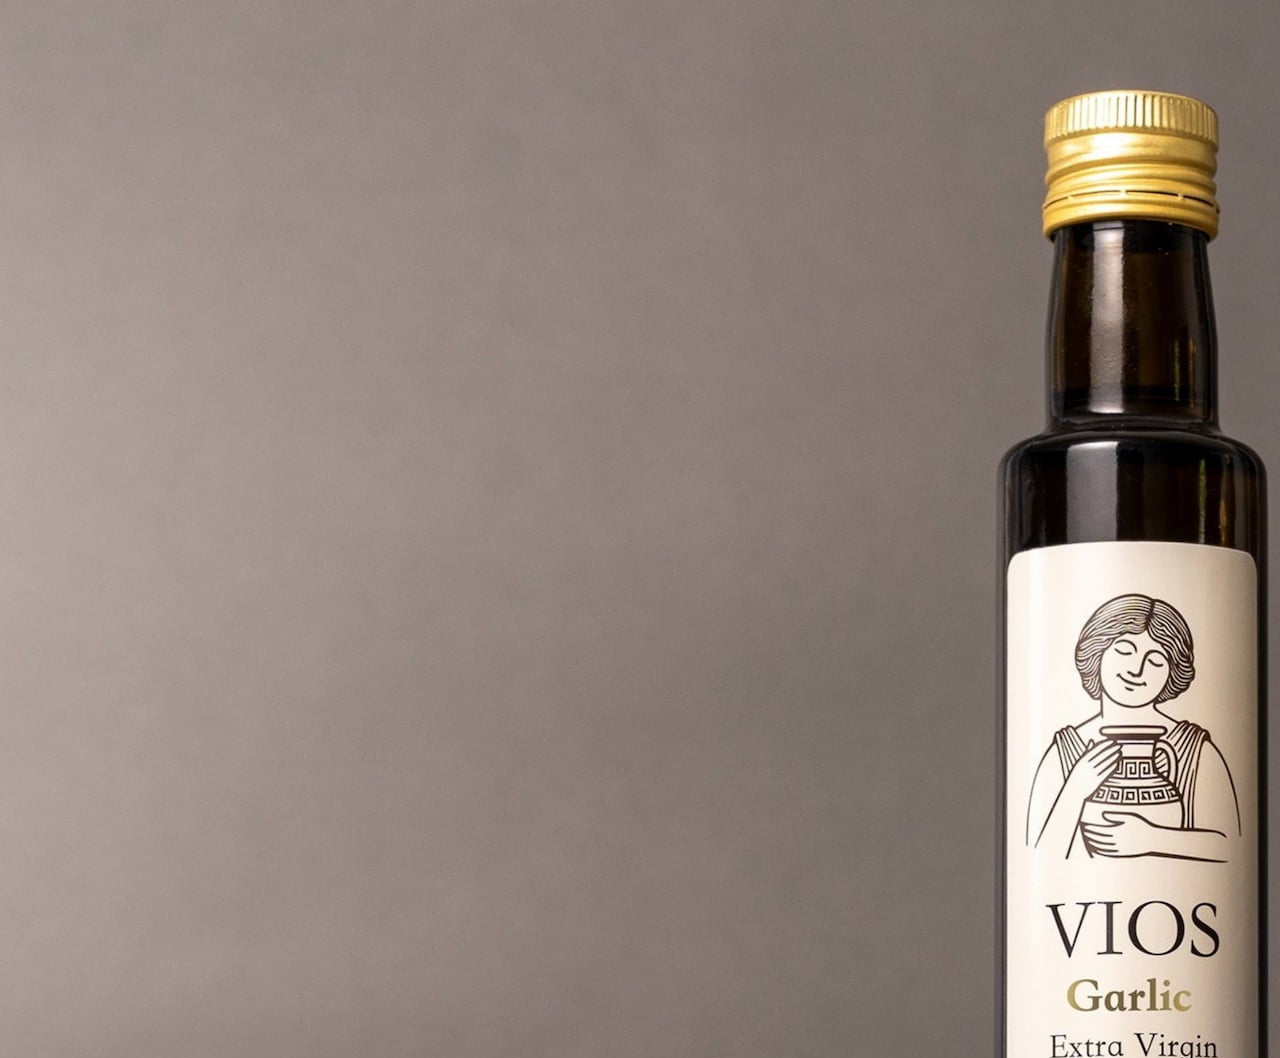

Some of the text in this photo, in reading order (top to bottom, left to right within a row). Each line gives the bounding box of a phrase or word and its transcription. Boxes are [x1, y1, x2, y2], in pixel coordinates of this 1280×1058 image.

[1045, 901, 1219, 958] VIOS
[1067, 978, 1191, 1012] Garlic
[1050, 1034, 1124, 1058] Extra
